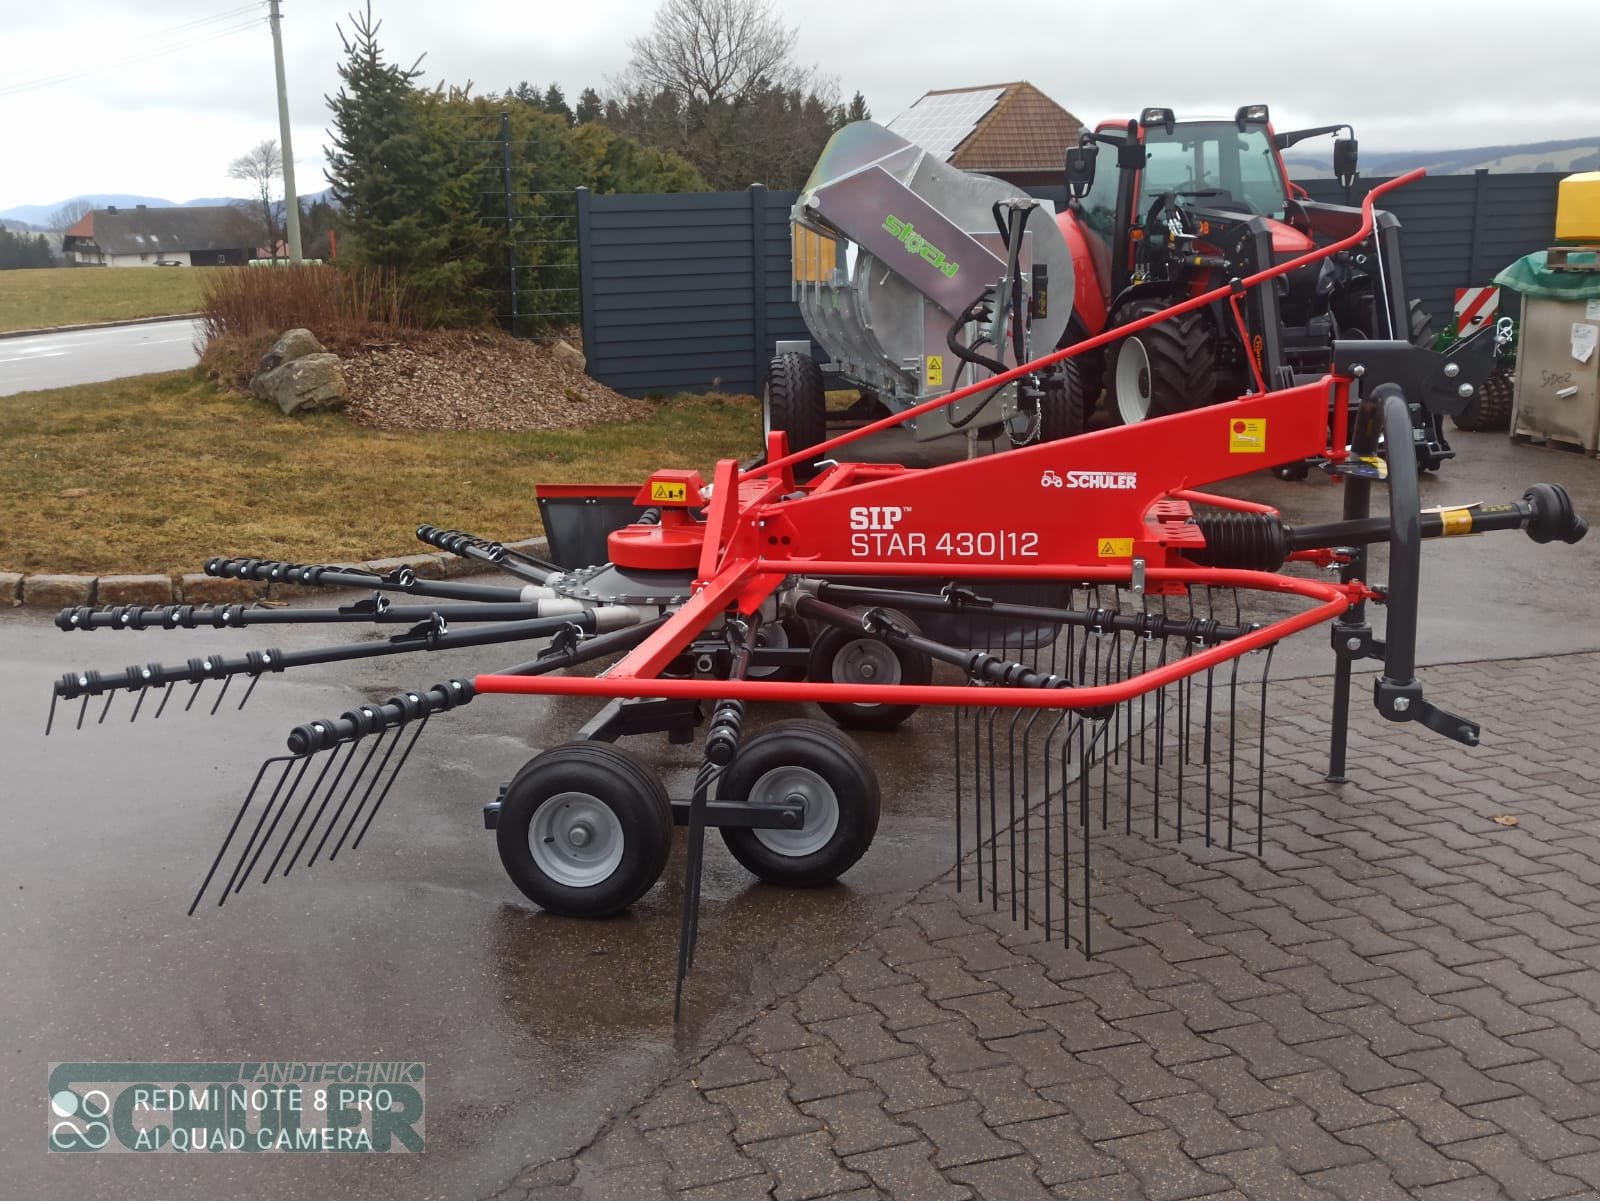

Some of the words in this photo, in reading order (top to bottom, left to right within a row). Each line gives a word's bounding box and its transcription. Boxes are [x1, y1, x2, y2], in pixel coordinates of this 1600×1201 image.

[1066, 470, 1137, 489] SCHULER
[850, 506, 902, 530] SIP
[851, 532, 927, 557] STAR
